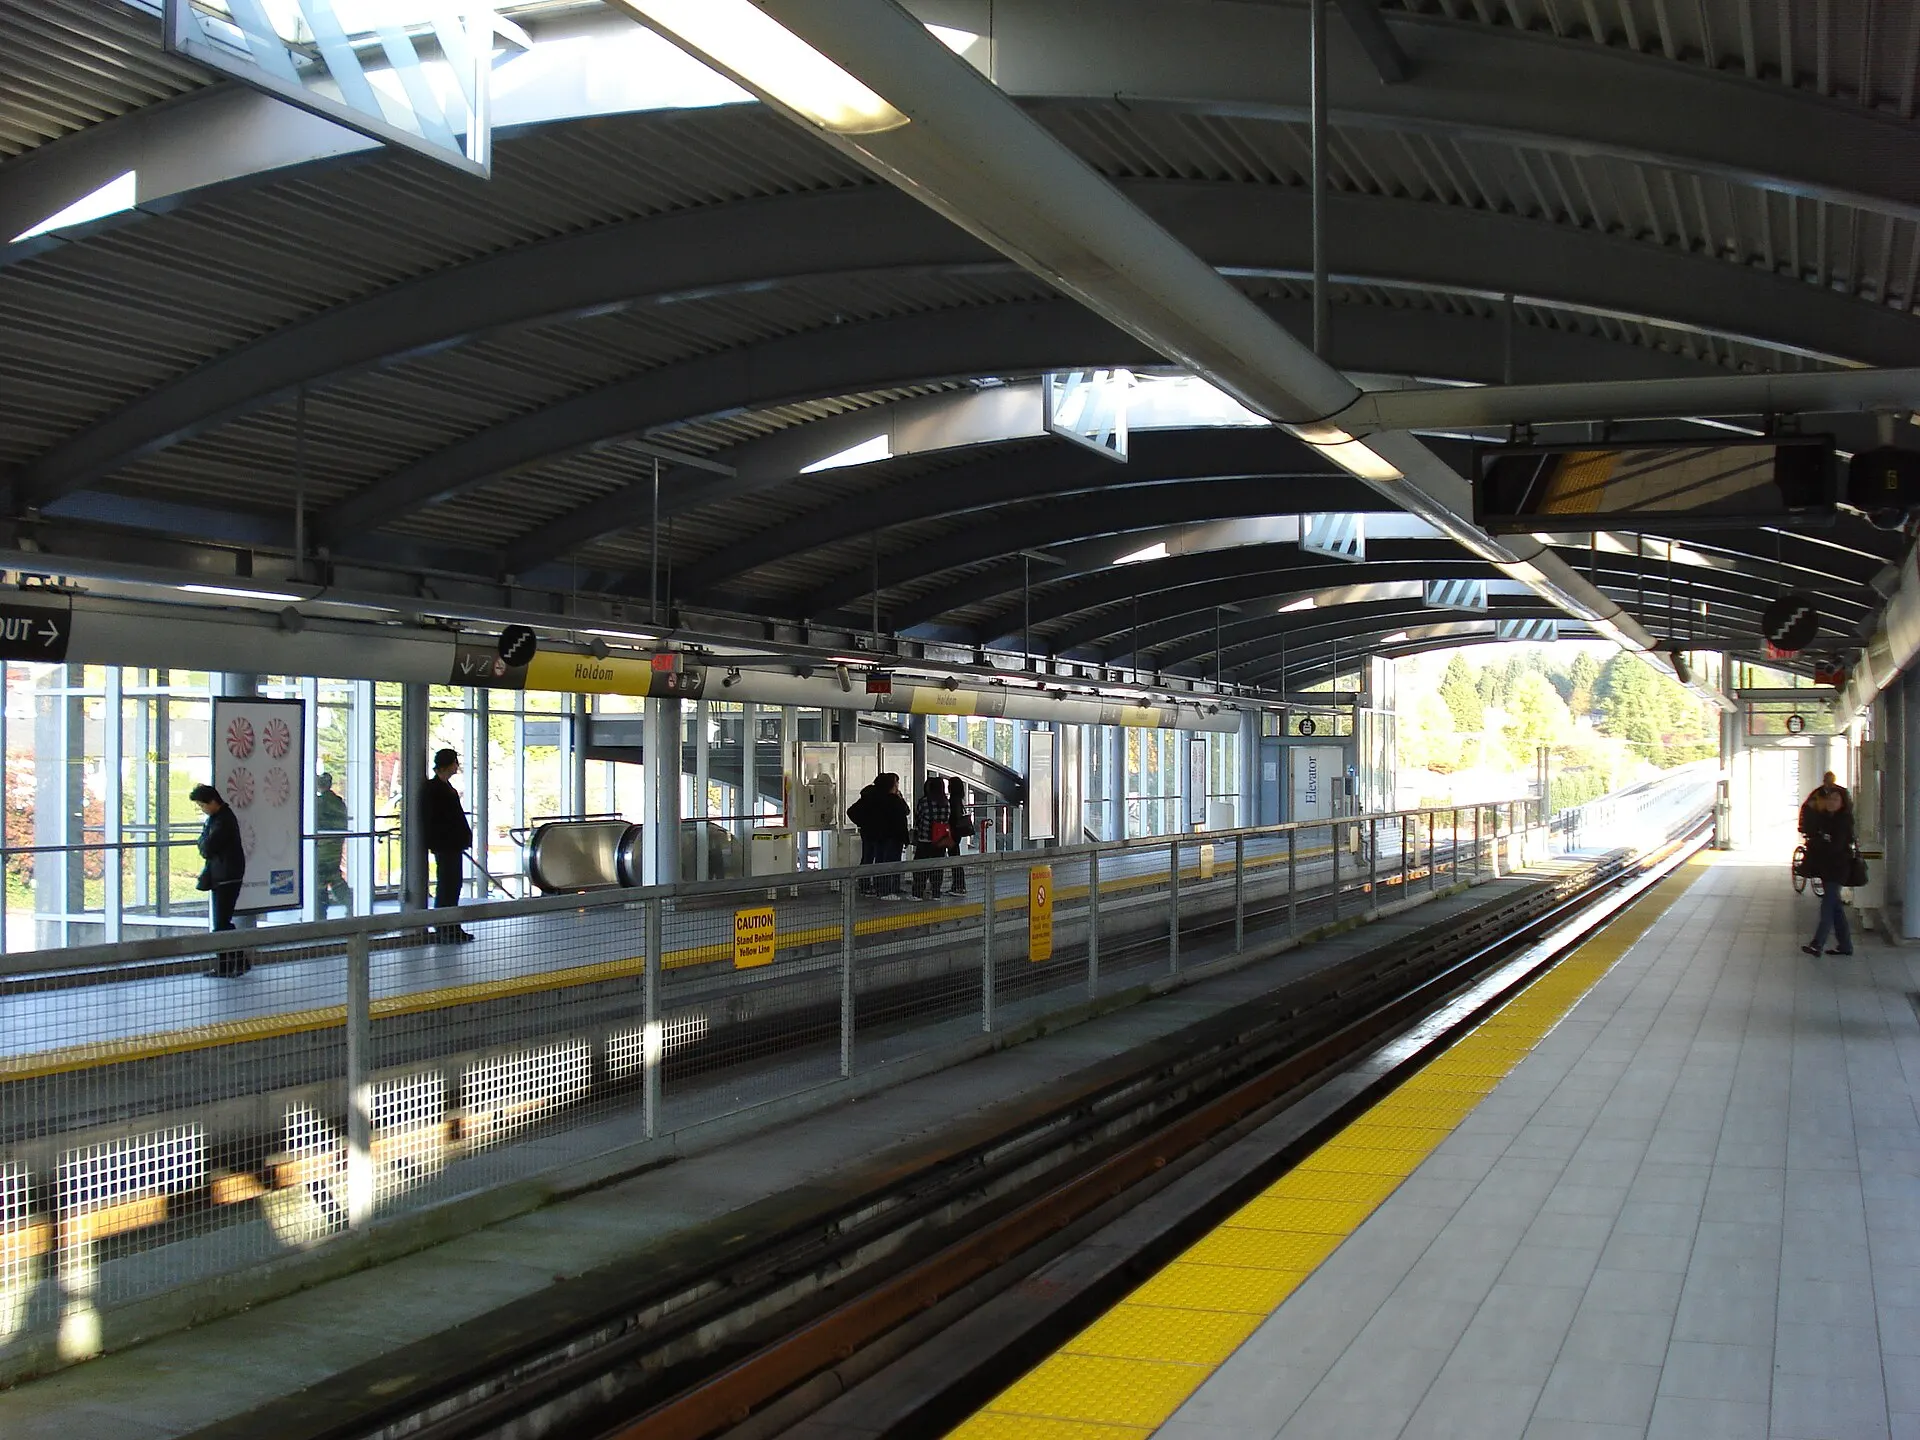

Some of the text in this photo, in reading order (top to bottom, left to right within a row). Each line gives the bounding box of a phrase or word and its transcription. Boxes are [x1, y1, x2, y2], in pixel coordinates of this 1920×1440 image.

[574, 663, 614, 680] Holdom
[1305, 755, 1317, 804] Elevator
[737, 914, 773, 930] CAUTION
[737, 931, 774, 945] Stand Behind
[739, 944, 770, 957] Yellow Line
